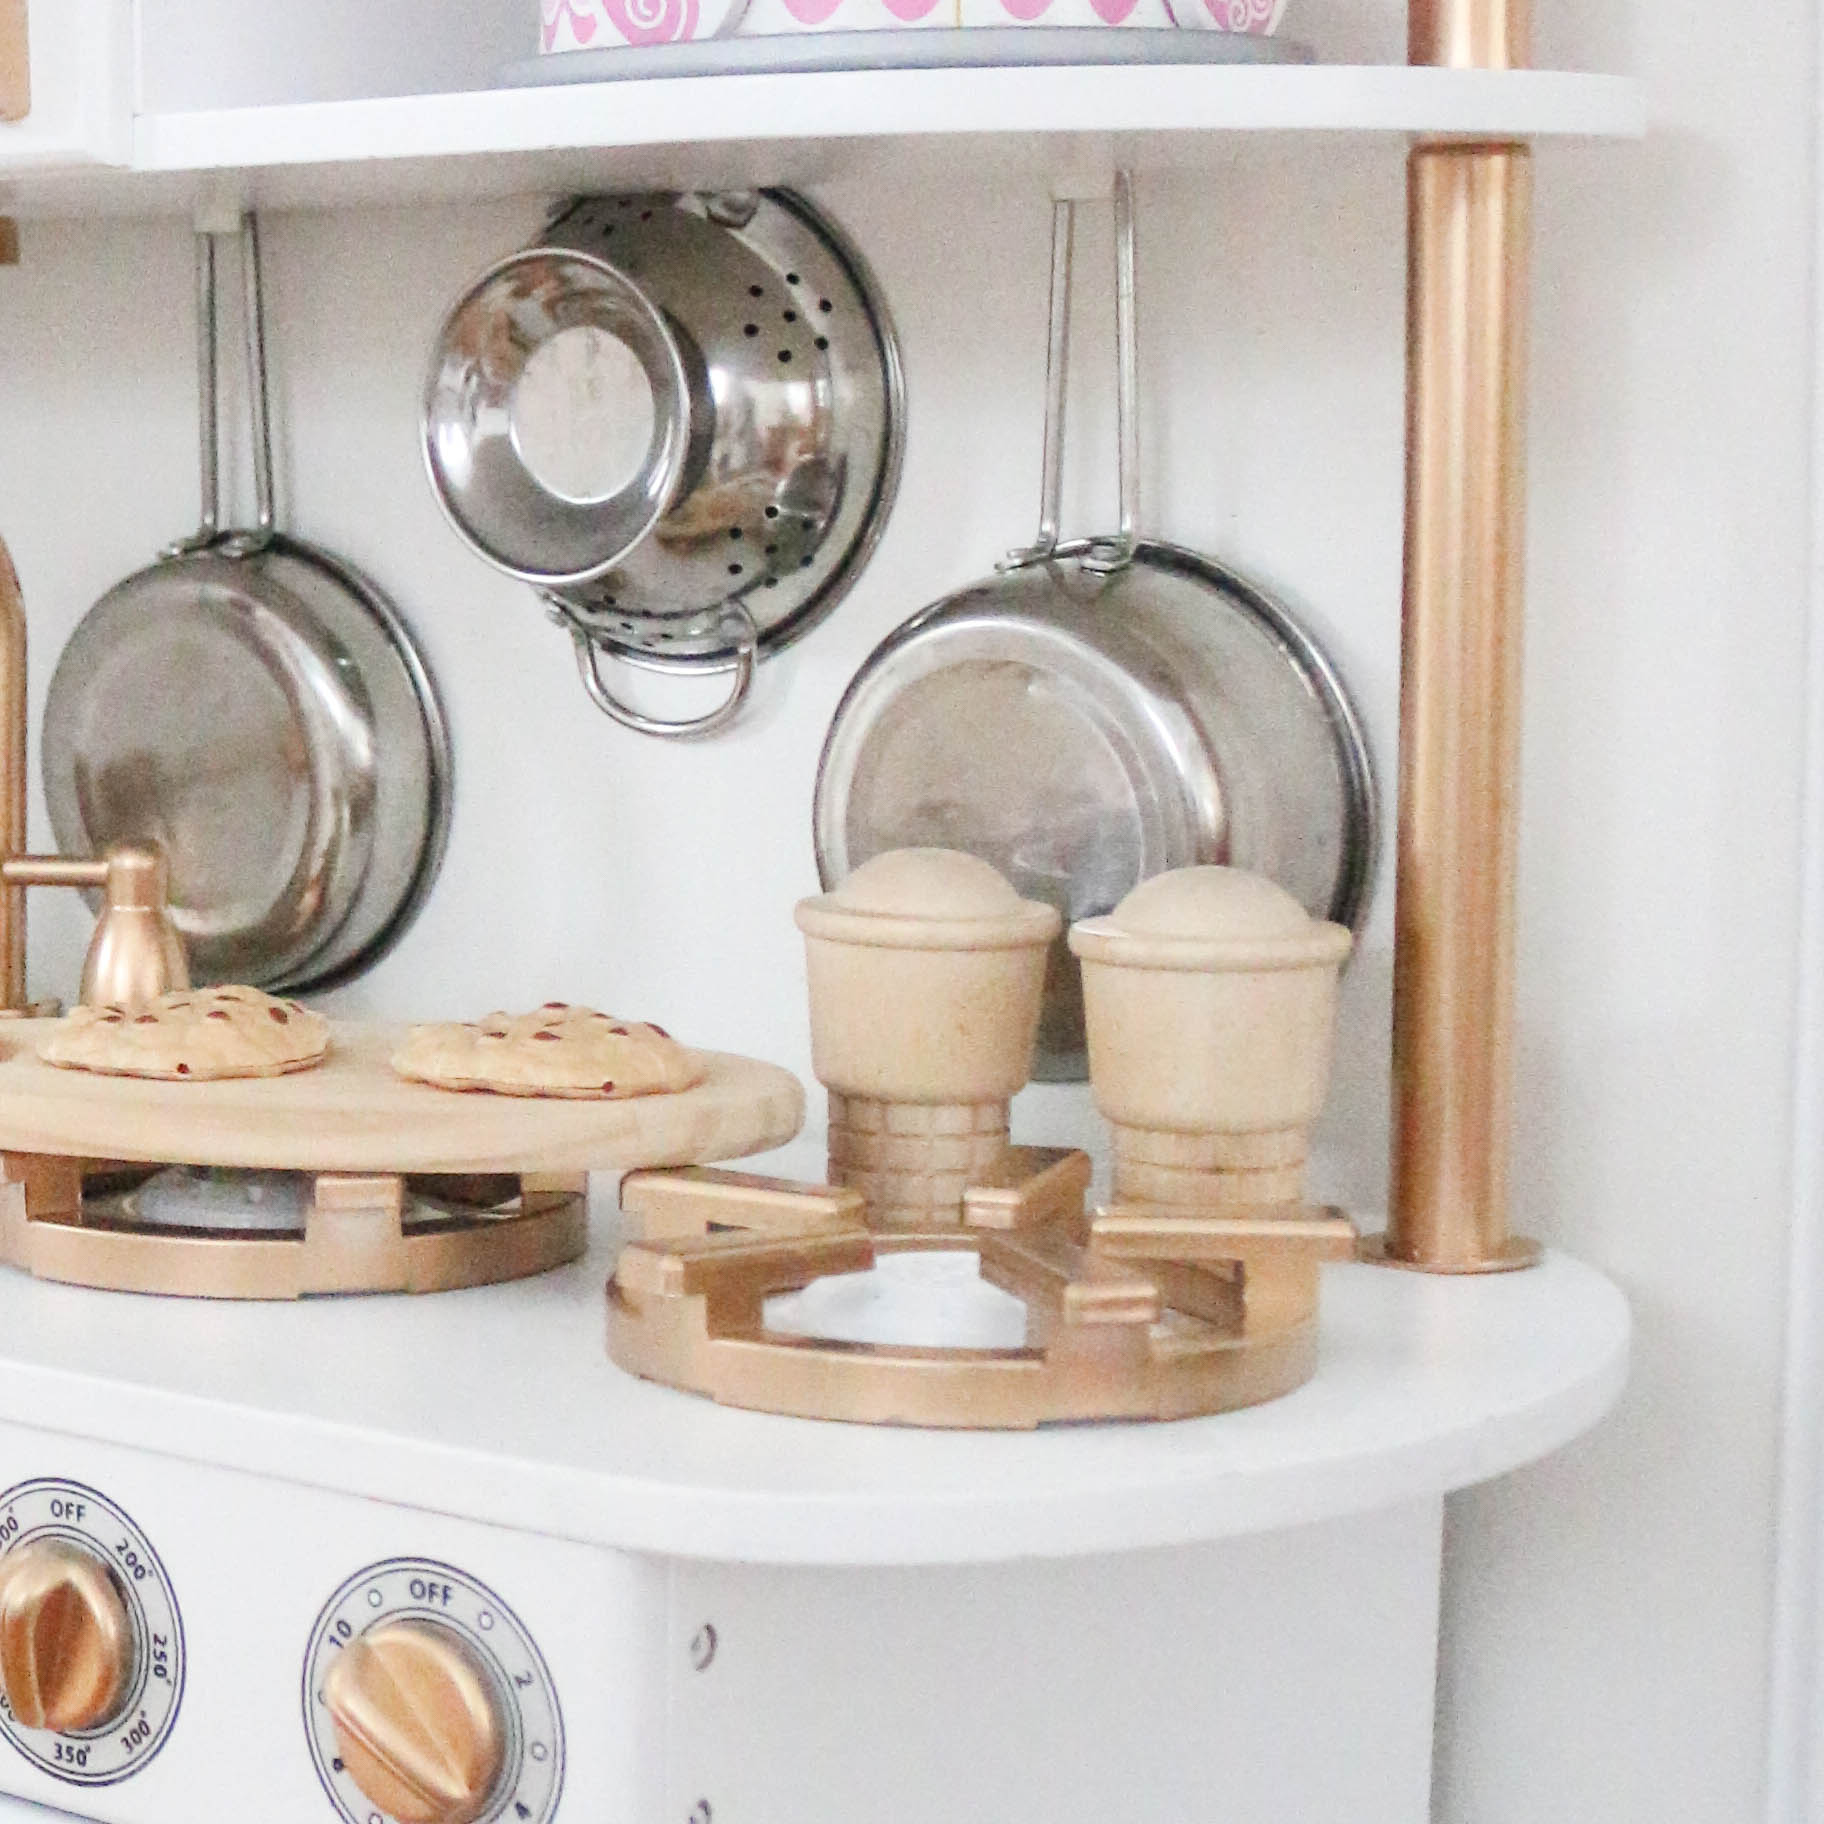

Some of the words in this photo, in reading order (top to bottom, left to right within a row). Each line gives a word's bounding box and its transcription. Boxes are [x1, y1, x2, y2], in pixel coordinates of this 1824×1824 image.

[50, 1498, 87, 1522] OFF
[409, 1578, 453, 1606] OFF
[329, 1619, 353, 1649] 10
[514, 1670, 535, 1690] 2
[515, 1800, 532, 1821] 4
